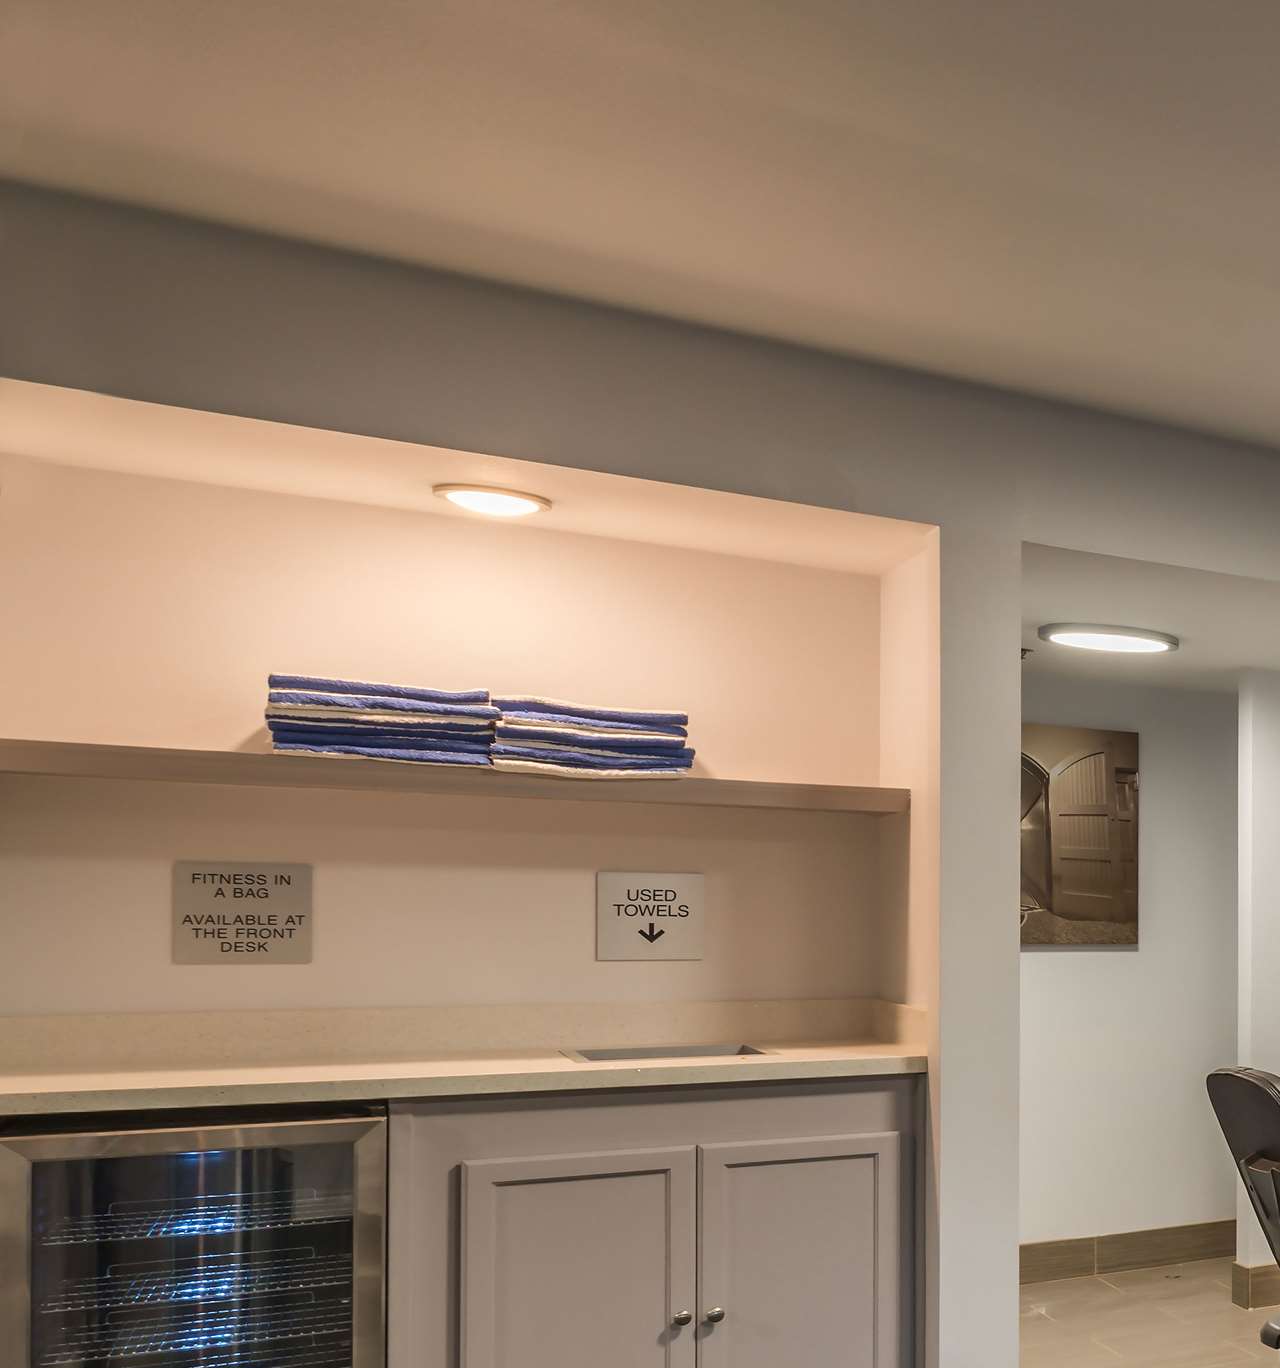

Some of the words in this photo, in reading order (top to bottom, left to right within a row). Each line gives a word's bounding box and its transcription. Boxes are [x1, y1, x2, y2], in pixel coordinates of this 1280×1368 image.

[191, 873, 267, 885] FITNESS
[274, 875, 291, 886] IN
[214, 887, 226, 898] A
[233, 887, 269, 899] BAG
[626, 888, 677, 902] USED
[612, 904, 690, 918] TOWELS
[182, 914, 278, 926] AVAILABLE
[285, 915, 305, 926] AT
[191, 928, 228, 939] THE
[235, 928, 296, 939] FRONT
[220, 941, 269, 953] DESK
